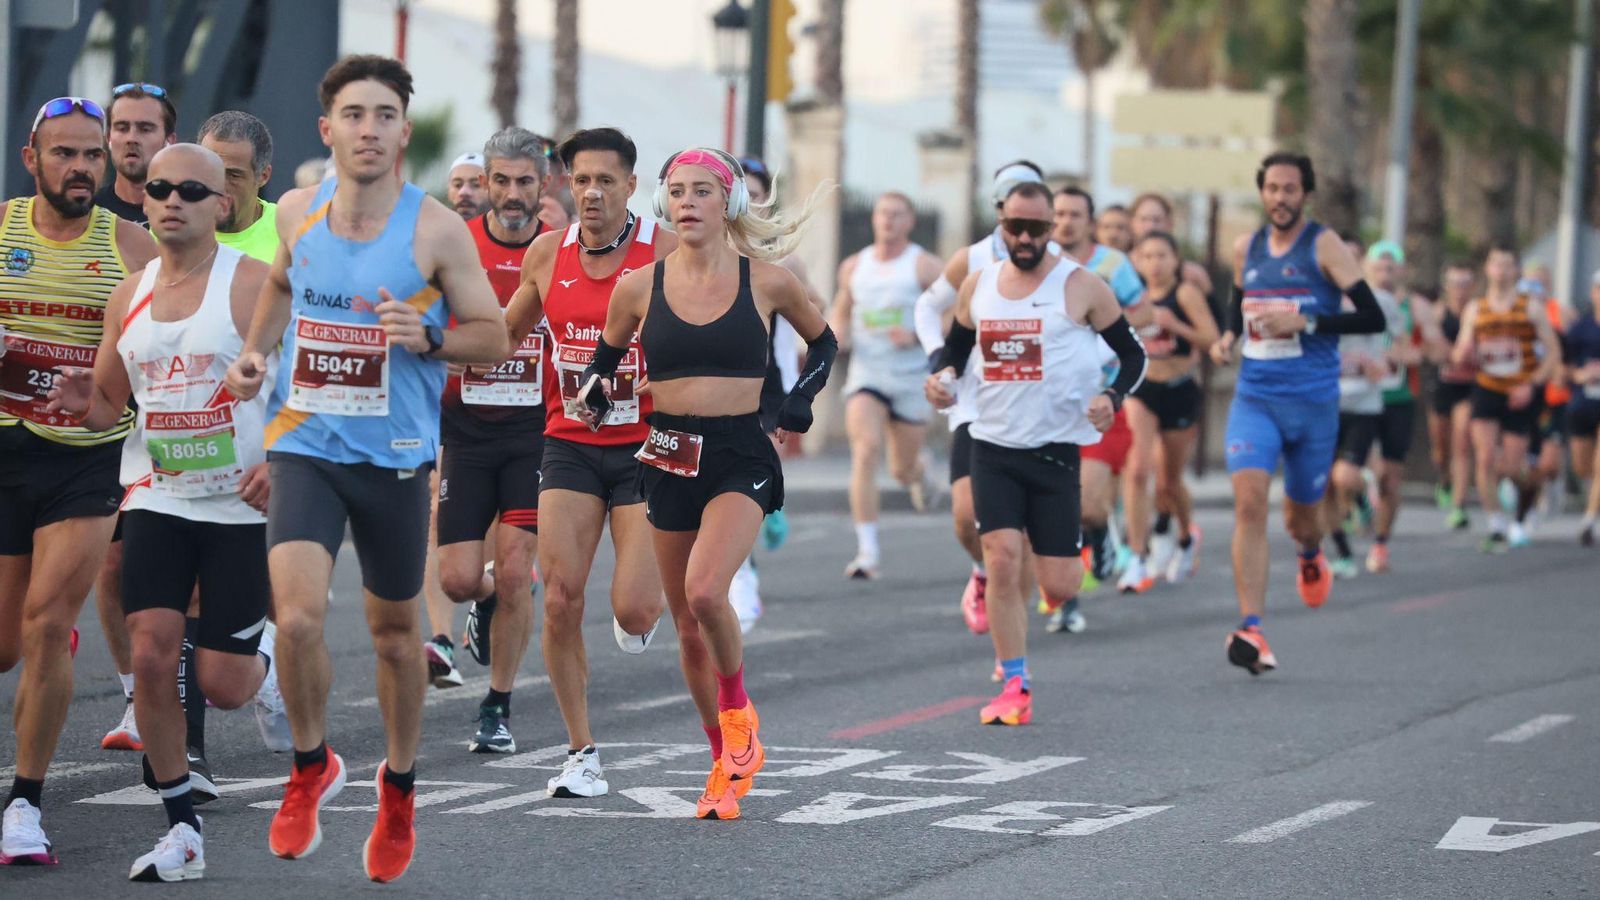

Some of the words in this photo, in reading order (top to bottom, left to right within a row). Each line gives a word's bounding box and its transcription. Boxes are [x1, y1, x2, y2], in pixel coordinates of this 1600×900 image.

[313, 325, 382, 345] GENERALI
[26, 342, 94, 362] GENERALI
[991, 341, 1025, 354] 4826
[307, 353, 366, 375] 15047
[491, 360, 525, 374] 278
[165, 410, 226, 429] GENERALI
[650, 429, 679, 451] 5986
[161, 441, 219, 460] 18056
